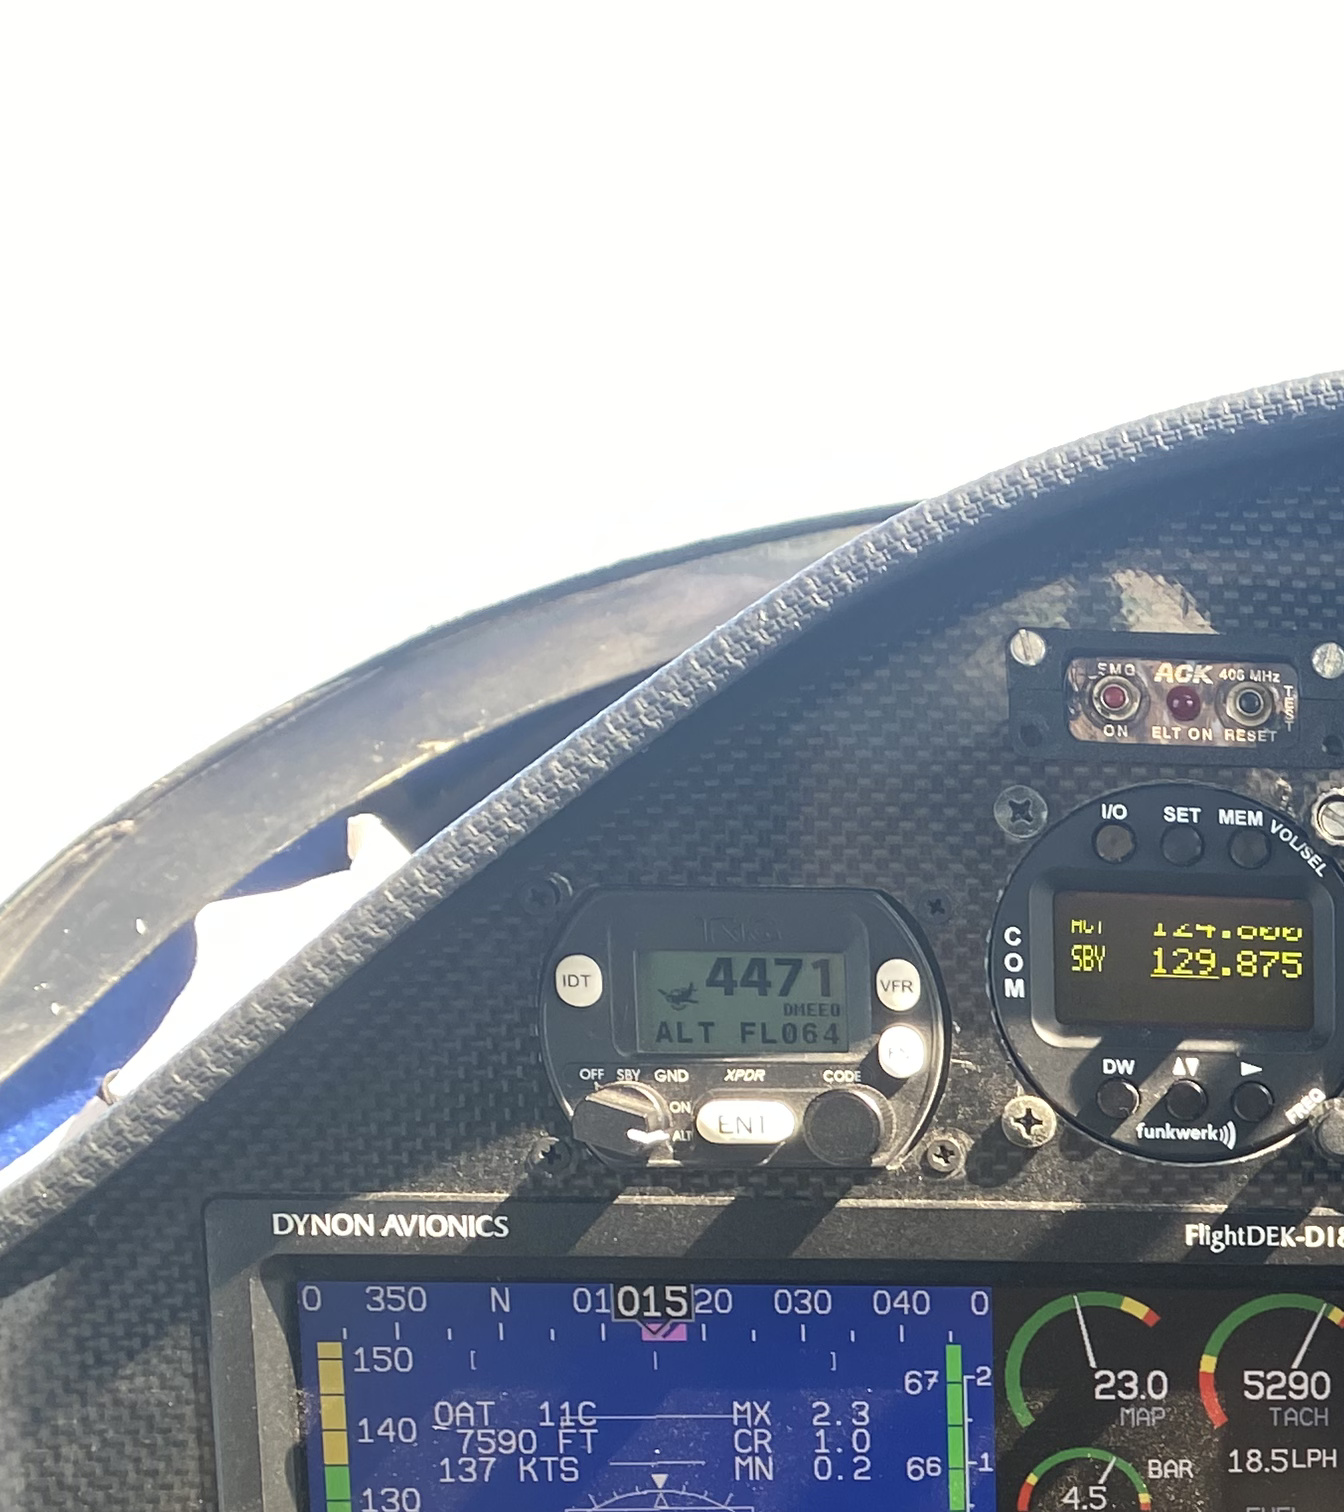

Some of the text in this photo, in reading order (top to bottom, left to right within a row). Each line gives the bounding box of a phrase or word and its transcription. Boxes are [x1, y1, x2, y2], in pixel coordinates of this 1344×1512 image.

[1154, 663, 1213, 684] ACK
[1104, 726, 1128, 738] ON
[1152, 727, 1213, 741] ELT ON
[1225, 728, 1276, 743] RESET
[1101, 804, 1127, 819] I/O
[1163, 806, 1201, 822] SET
[1219, 810, 1263, 826] MEM
[1270, 820, 1327, 878] VOL/SEL
[1071, 946, 1303, 977] SBY 129.875
[562, 974, 590, 988] IDT
[706, 958, 834, 997] 4471
[881, 978, 913, 994] VFR
[656, 1022, 840, 1044] ALT FL064
[580, 1068, 604, 1081] OFF
[616, 1068, 640, 1081] SBY
[724, 1069, 765, 1082] XPDR
[1103, 1059, 1134, 1074] DW
[655, 1069, 689, 1083] GND
[823, 1069, 862, 1083] CODE
[669, 1101, 691, 1115] ON
[1137, 1124, 1218, 1144] funkwerk
[273, 1213, 509, 1238] DYNON AVIONICS
[490, 1288, 511, 1313] N
[618, 1286, 687, 1316] 015
[774, 1290, 832, 1314] 030
[353, 1348, 413, 1372] 150
[1094, 1371, 1168, 1400] 23.0
[1243, 1372, 1331, 1400] 5290
[434, 1402, 597, 1426] OAT 11C
[1120, 1407, 1165, 1426] MAP
[1270, 1408, 1329, 1426] TACH
[459, 1429, 598, 1453] 7590 FT
[1148, 1460, 1193, 1478] BAR
[362, 1489, 420, 1512] 130
